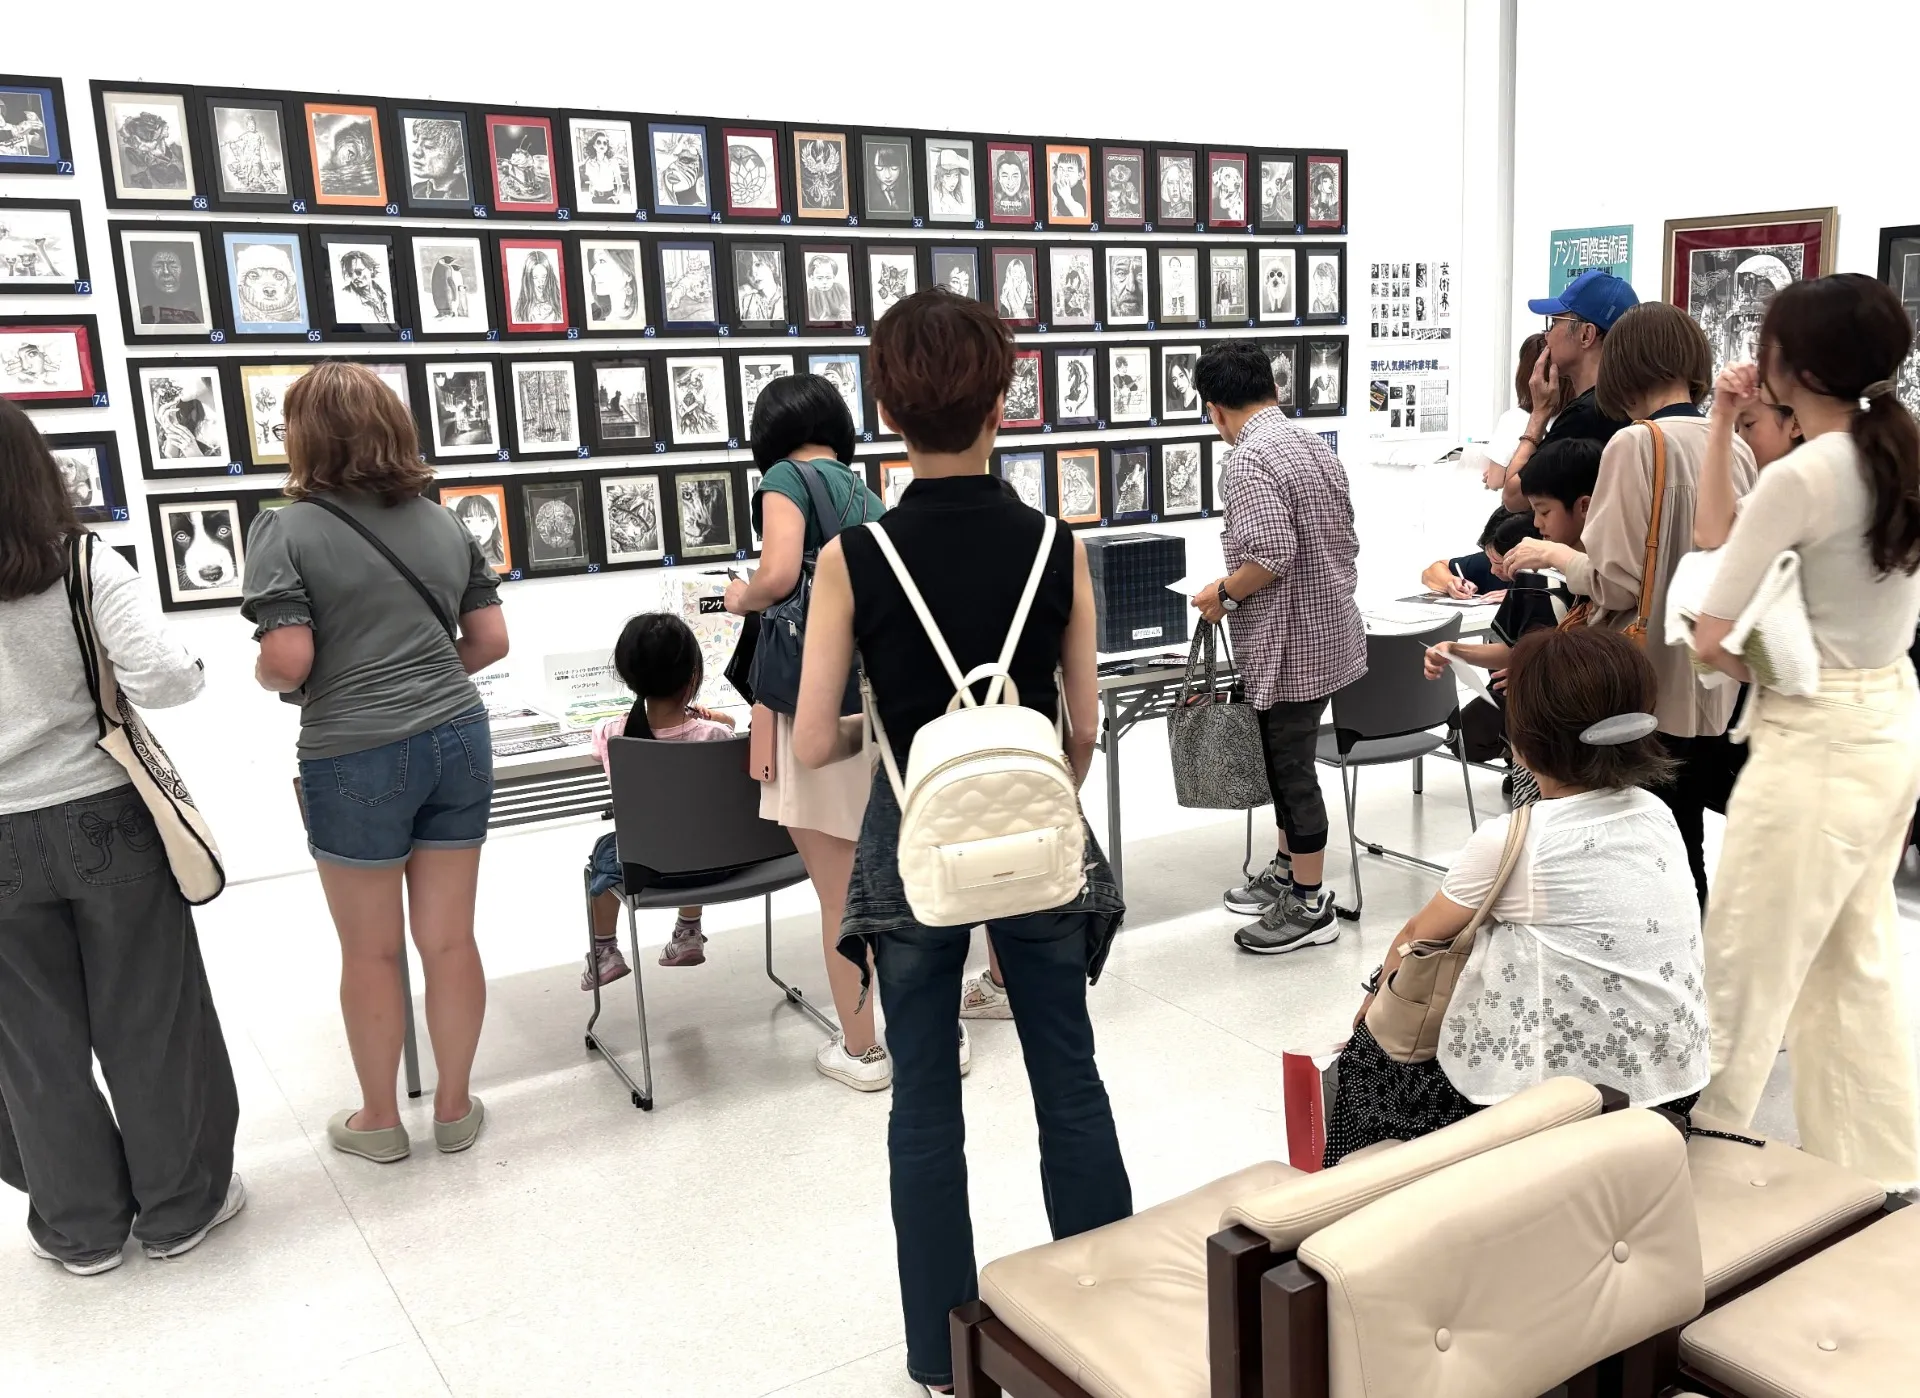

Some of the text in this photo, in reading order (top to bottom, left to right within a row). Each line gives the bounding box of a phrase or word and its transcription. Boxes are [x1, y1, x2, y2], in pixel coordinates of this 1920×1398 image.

[58, 161, 74, 173] 72
[193, 197, 208, 209] 68
[292, 201, 306, 212] 64
[385, 203, 399, 215] 60
[473, 206, 486, 217] 56
[557, 209, 569, 220] 52
[635, 210, 647, 221] 48
[711, 212, 721, 222] 44
[780, 214, 792, 224] 40
[848, 215, 858, 226] 36
[913, 217, 923, 228] 32
[975, 219, 985, 230] 28
[1034, 221, 1043, 231] 24
[1089, 222, 1099, 233] 20
[1144, 222, 1153, 233] 16
[1196, 223, 1204, 233] 12
[1553, 235, 1627, 266] アジア国際美術展
[76, 281, 91, 293] 73
[1038, 323, 1047, 333] 25
[1094, 321, 1102, 331] 21
[1147, 320, 1155, 330] 17
[1198, 319, 1206, 329] 13
[400, 330, 411, 341] 61
[485, 330, 497, 341] 57
[567, 328, 579, 339] 53
[644, 326, 656, 337] 49
[717, 326, 729, 336] 45
[788, 325, 798, 335] 41
[856, 325, 865, 335] 37
[210, 331, 224, 342] 69
[308, 330, 321, 342] 65
[94, 393, 109, 406] 74
[1200, 414, 1208, 424] 14
[1042, 424, 1052, 433] 26
[1097, 420, 1106, 430] 22
[863, 432, 873, 442] 38
[655, 442, 666, 453] 50
[727, 438, 739, 449] 46
[497, 449, 510, 462] 58
[577, 447, 589, 458] 54
[228, 462, 242, 475] 70
[114, 508, 128, 520] 75
[1151, 514, 1158, 524] 19
[1099, 518, 1109, 527] 23
[735, 549, 746, 560] 47
[663, 555, 674, 566] 51
[587, 563, 599, 574] 55
[509, 569, 522, 581] 59
